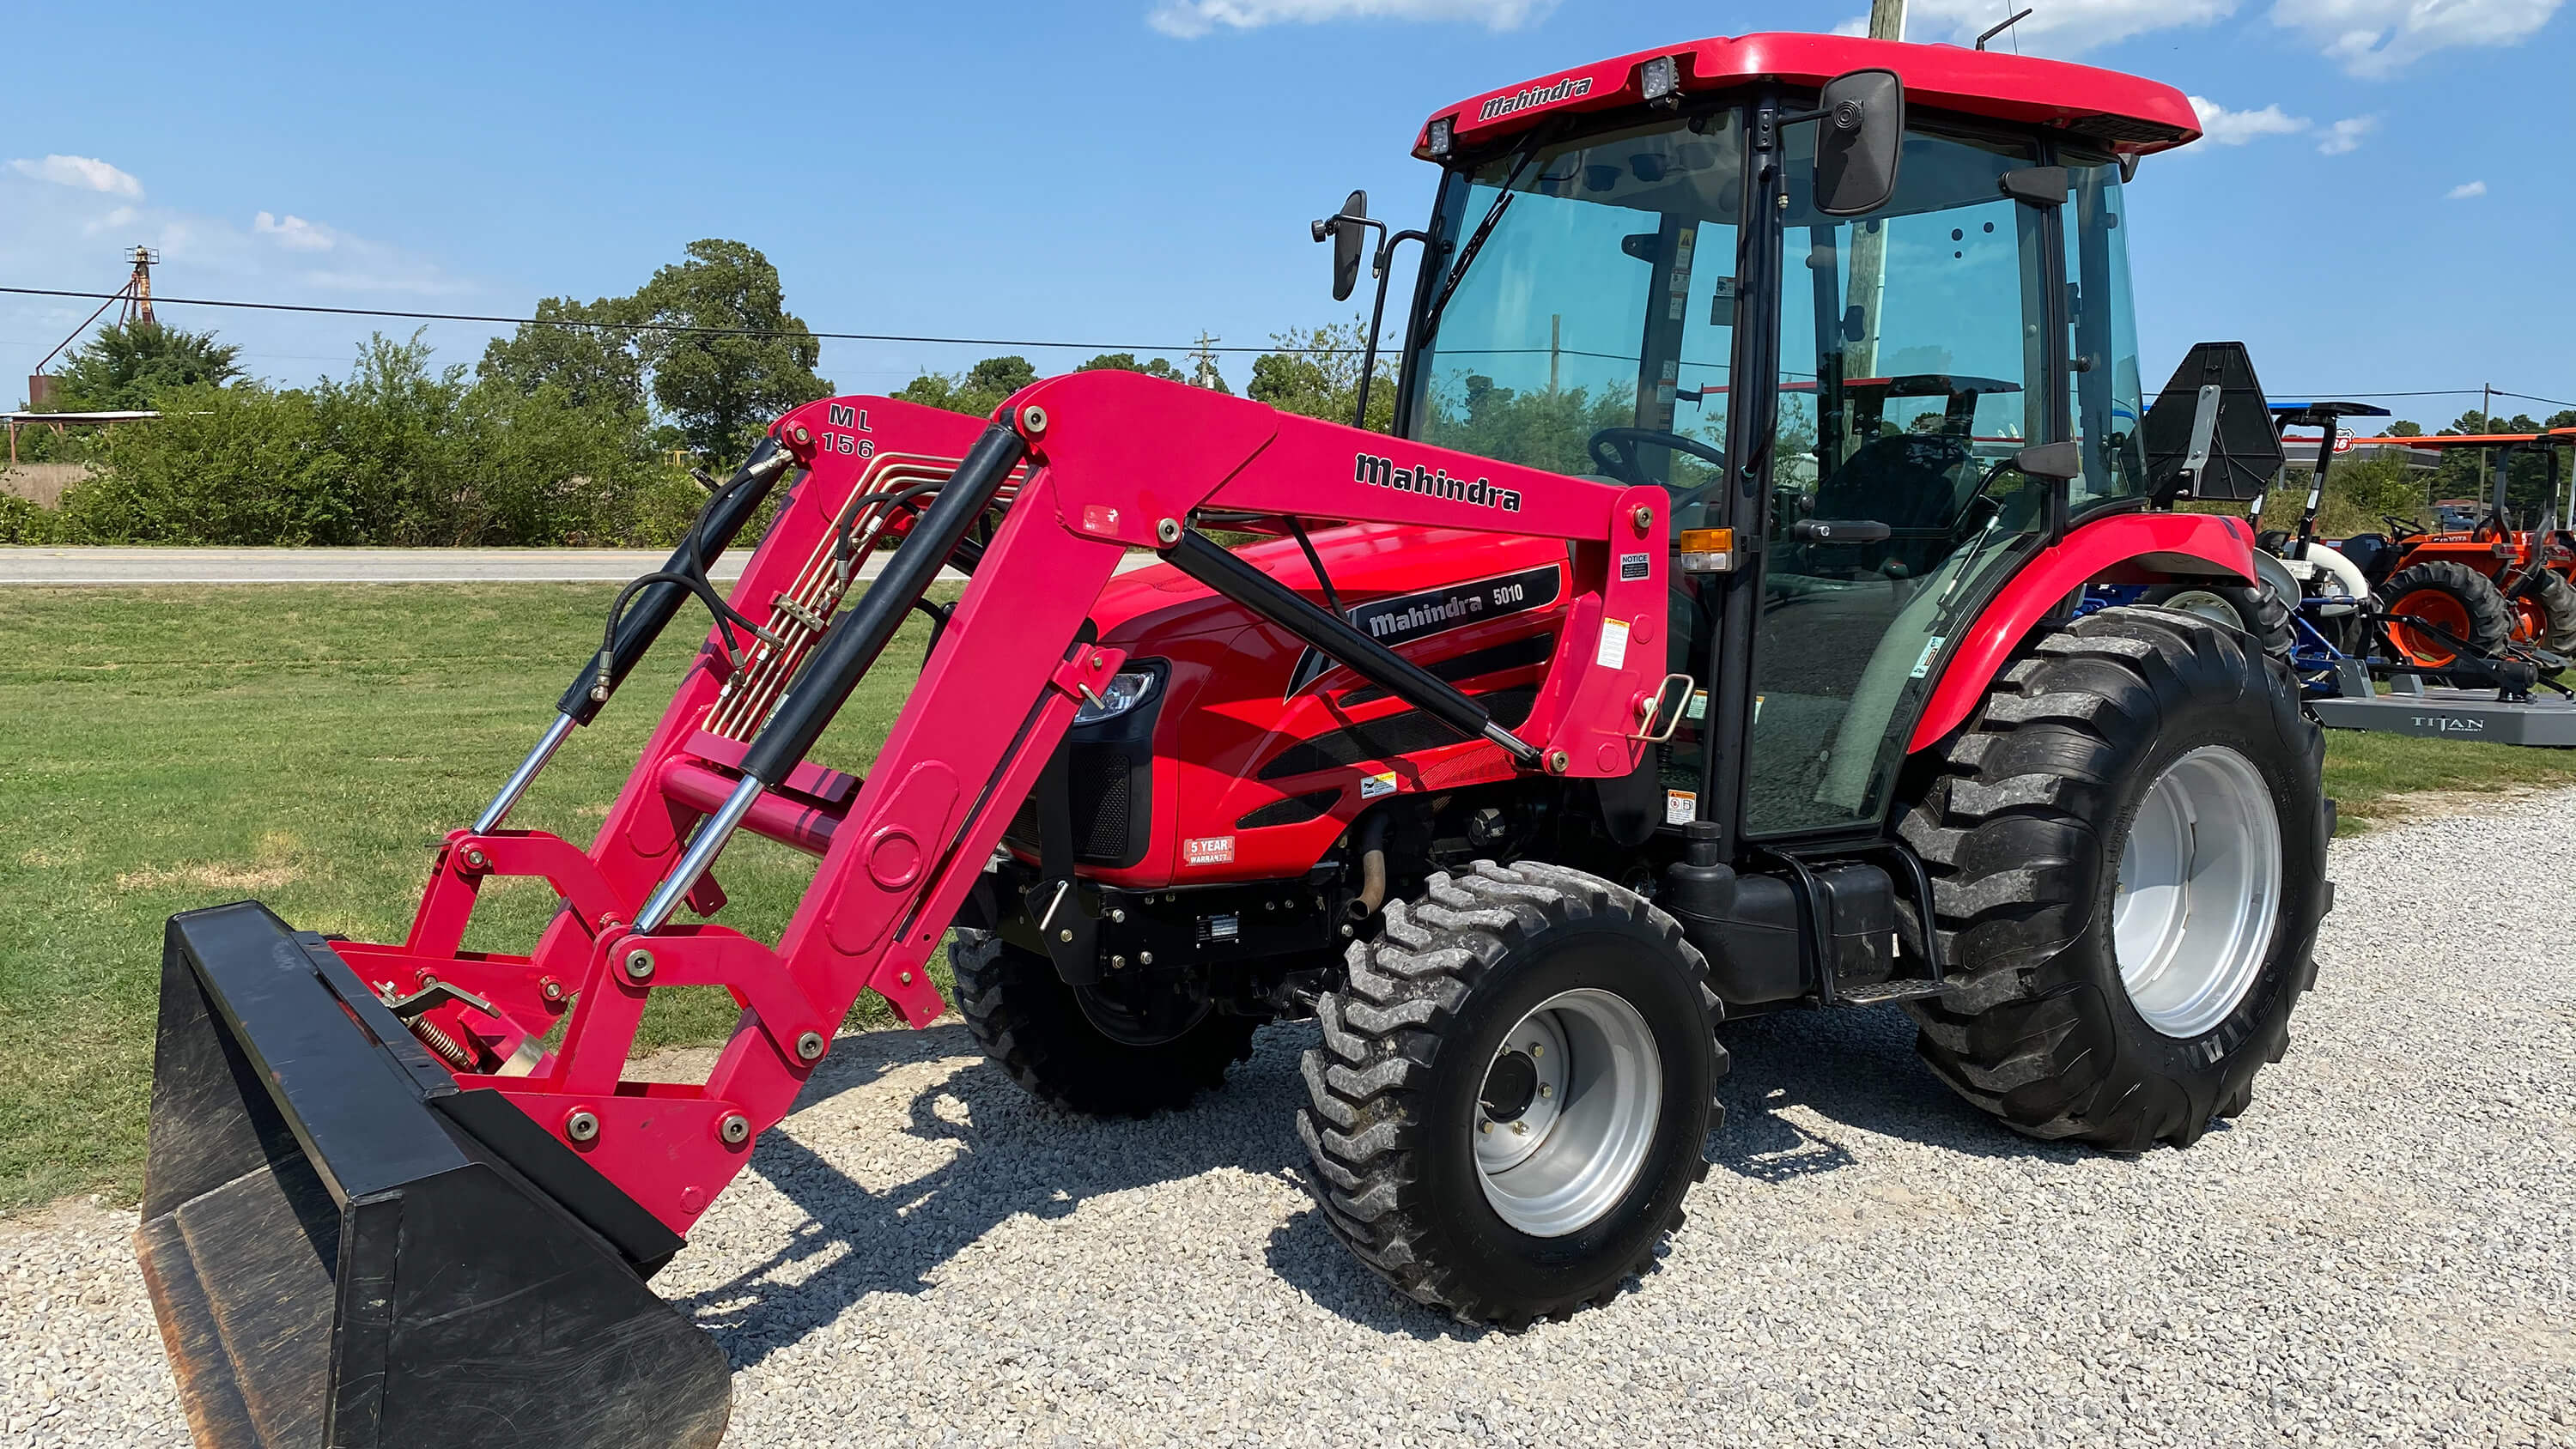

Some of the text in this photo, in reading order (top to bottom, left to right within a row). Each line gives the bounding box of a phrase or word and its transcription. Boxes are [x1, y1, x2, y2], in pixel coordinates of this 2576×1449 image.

[1479, 77, 1593, 122] Mahindra
[829, 403, 872, 433] ML
[822, 432, 875, 459] 156
[1354, 452, 1522, 512] Mahindra
[1370, 584, 1524, 637] Mahindra 5010
[2411, 716, 2484, 731] TITAN
[1191, 840, 1228, 853] 5 YEAR
